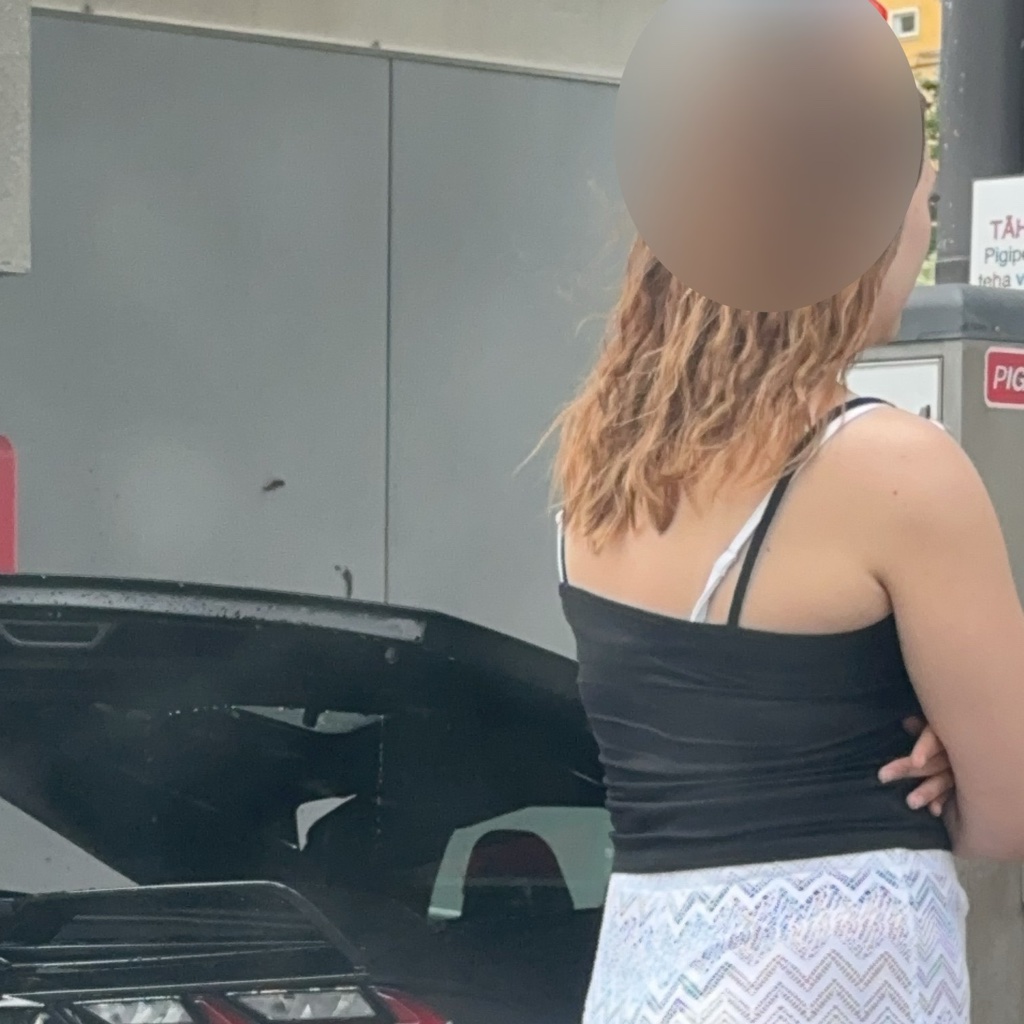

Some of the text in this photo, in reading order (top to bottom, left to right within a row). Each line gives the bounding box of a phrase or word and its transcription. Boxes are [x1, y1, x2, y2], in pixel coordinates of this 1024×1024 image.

[984, 245, 1024, 267] Pigip
[978, 271, 1011, 288] teha
[993, 365, 1024, 392] PIG
